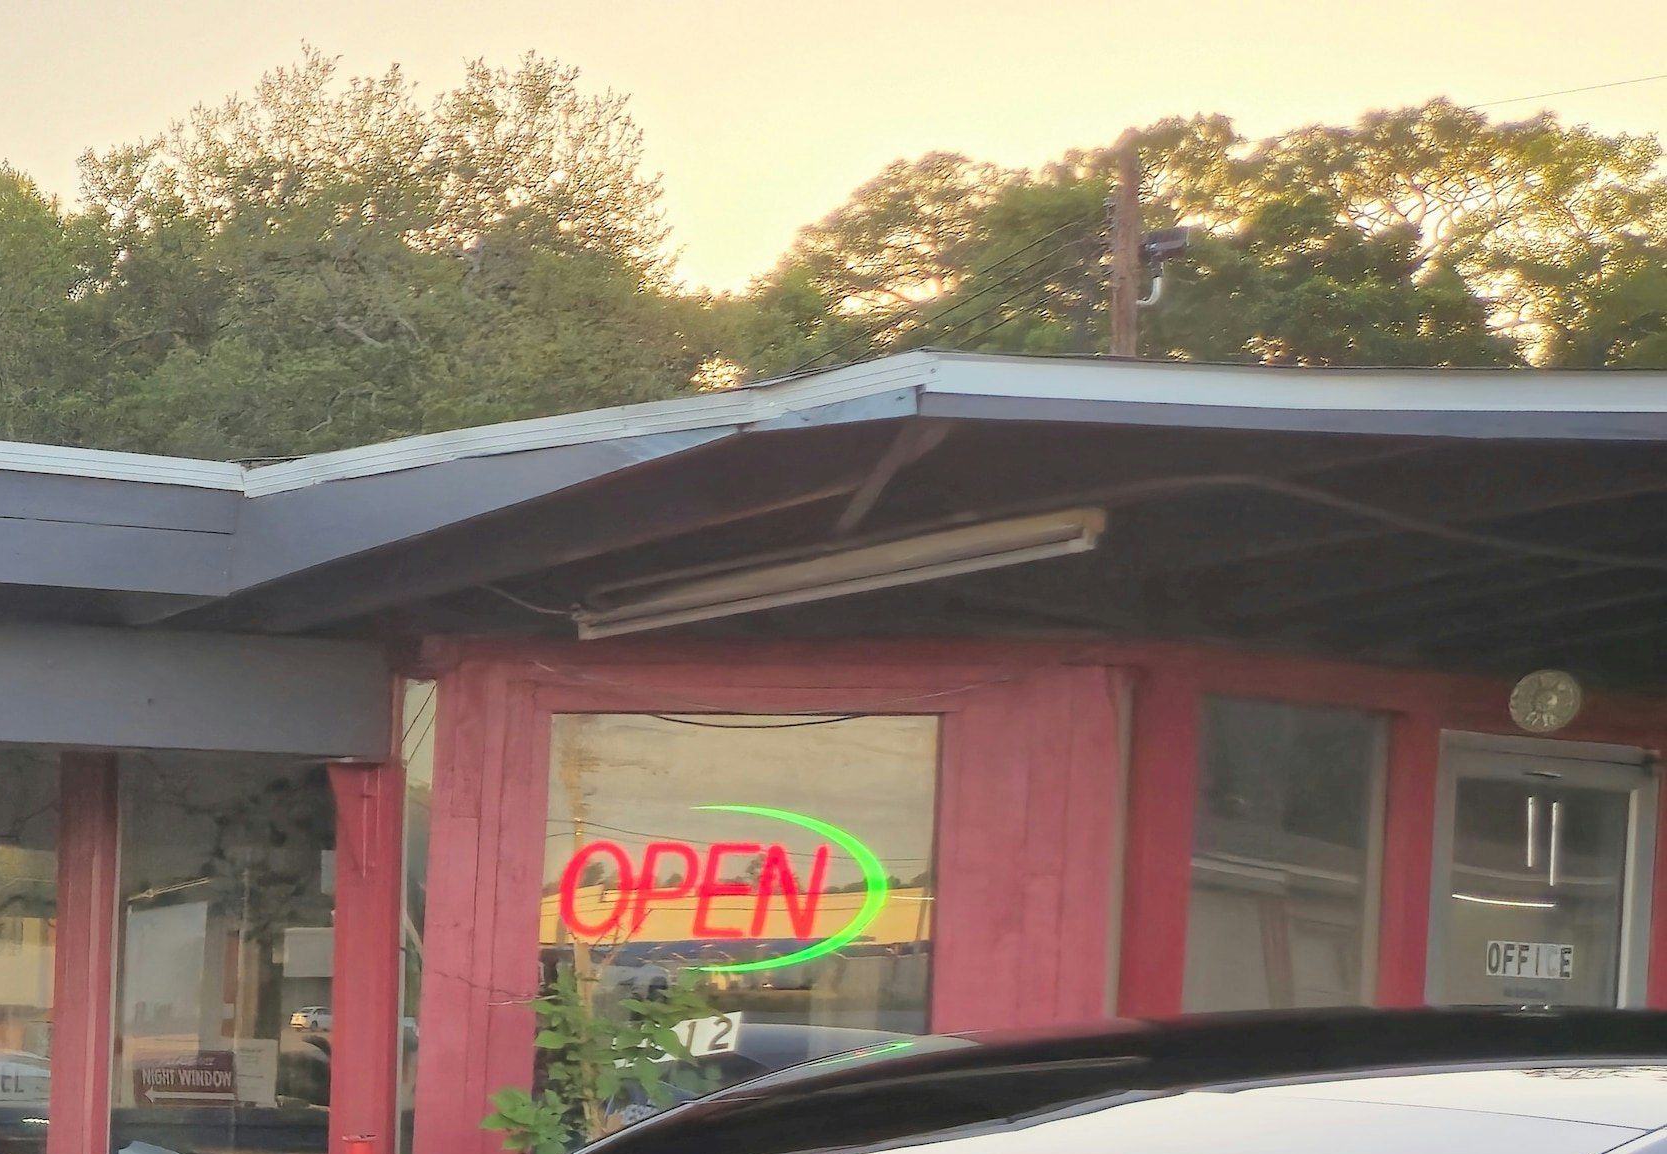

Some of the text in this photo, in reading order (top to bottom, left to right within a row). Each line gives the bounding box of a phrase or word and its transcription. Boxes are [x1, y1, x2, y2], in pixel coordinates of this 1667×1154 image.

[559, 838, 831, 940] OPEN
[1488, 942, 1572, 978] OFFICE
[141, 1068, 232, 1087] NIGHT WINDOW
